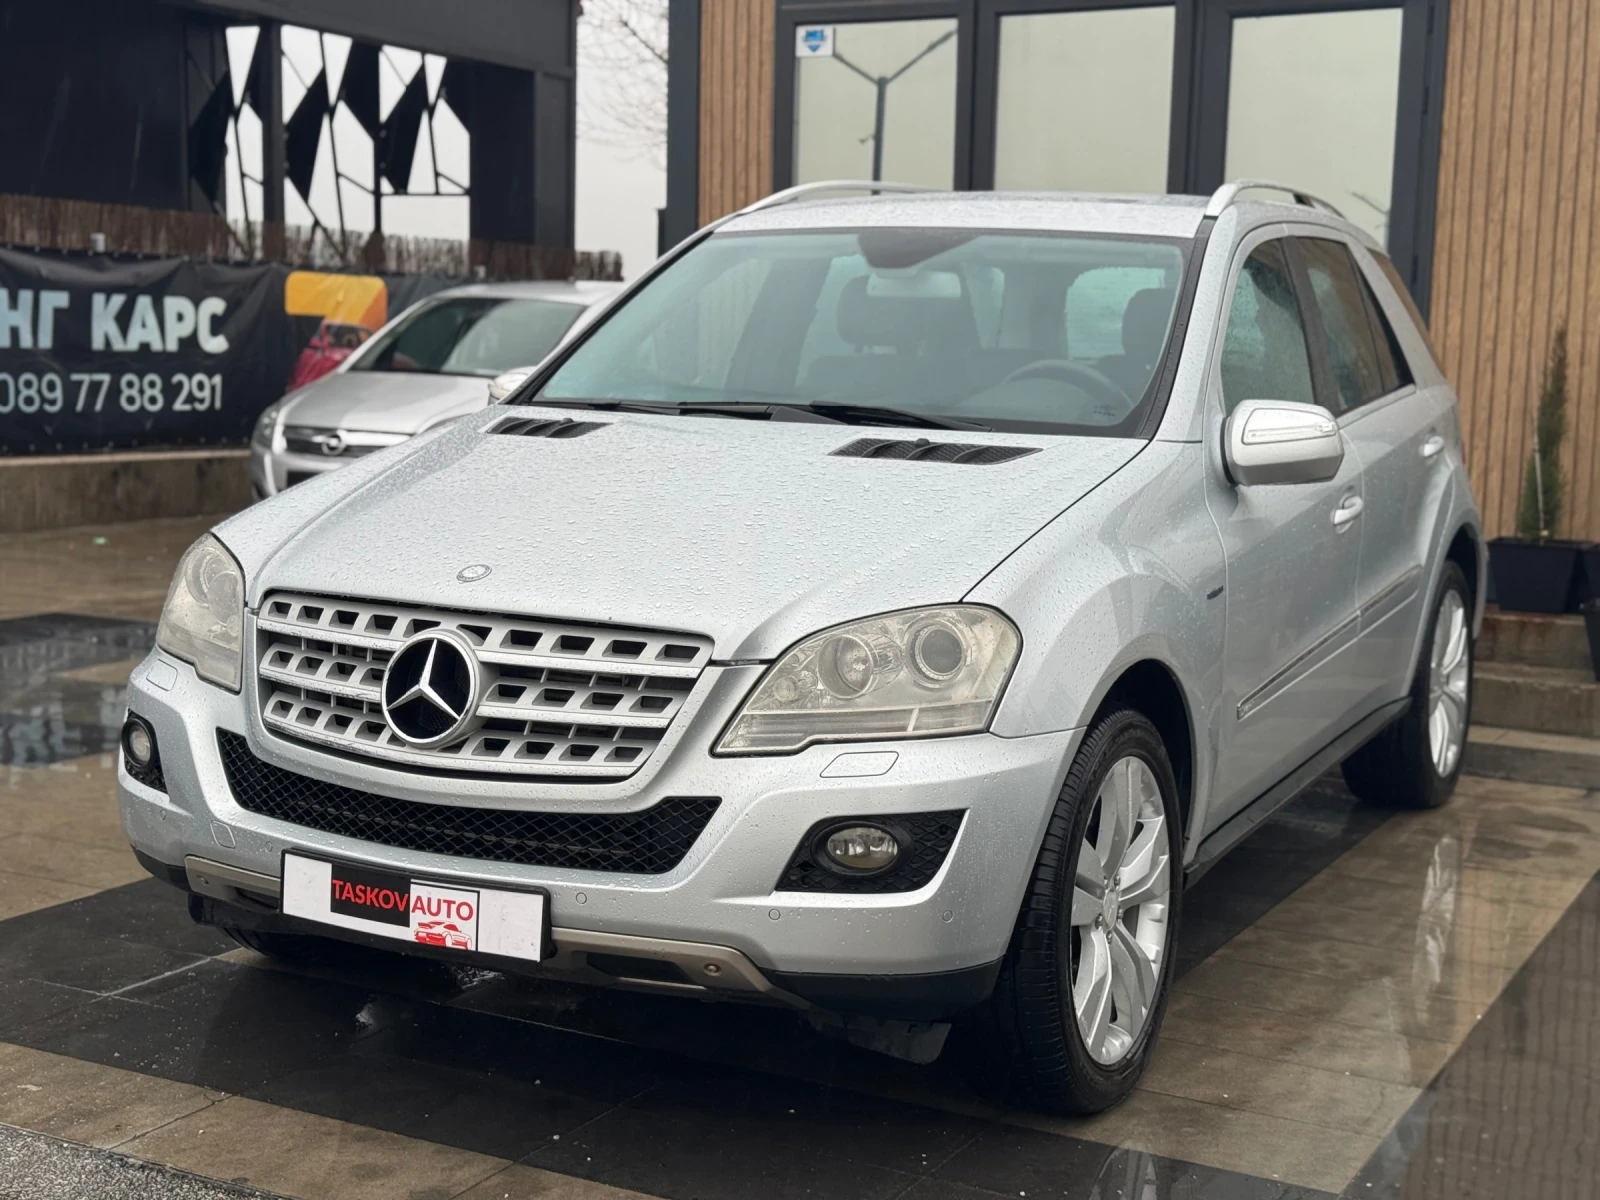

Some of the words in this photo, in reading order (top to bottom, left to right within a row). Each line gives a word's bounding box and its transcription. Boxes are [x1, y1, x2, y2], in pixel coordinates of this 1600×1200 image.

[0, 287, 70, 350] НГ
[91, 292, 229, 354] КАРС
[0, 372, 63, 414] 089
[70, 373, 111, 413] 77
[119, 373, 164, 412] 88
[171, 373, 222, 412] 291
[332, 879, 409, 912] TASKOV
[411, 896, 474, 921] AUTO
